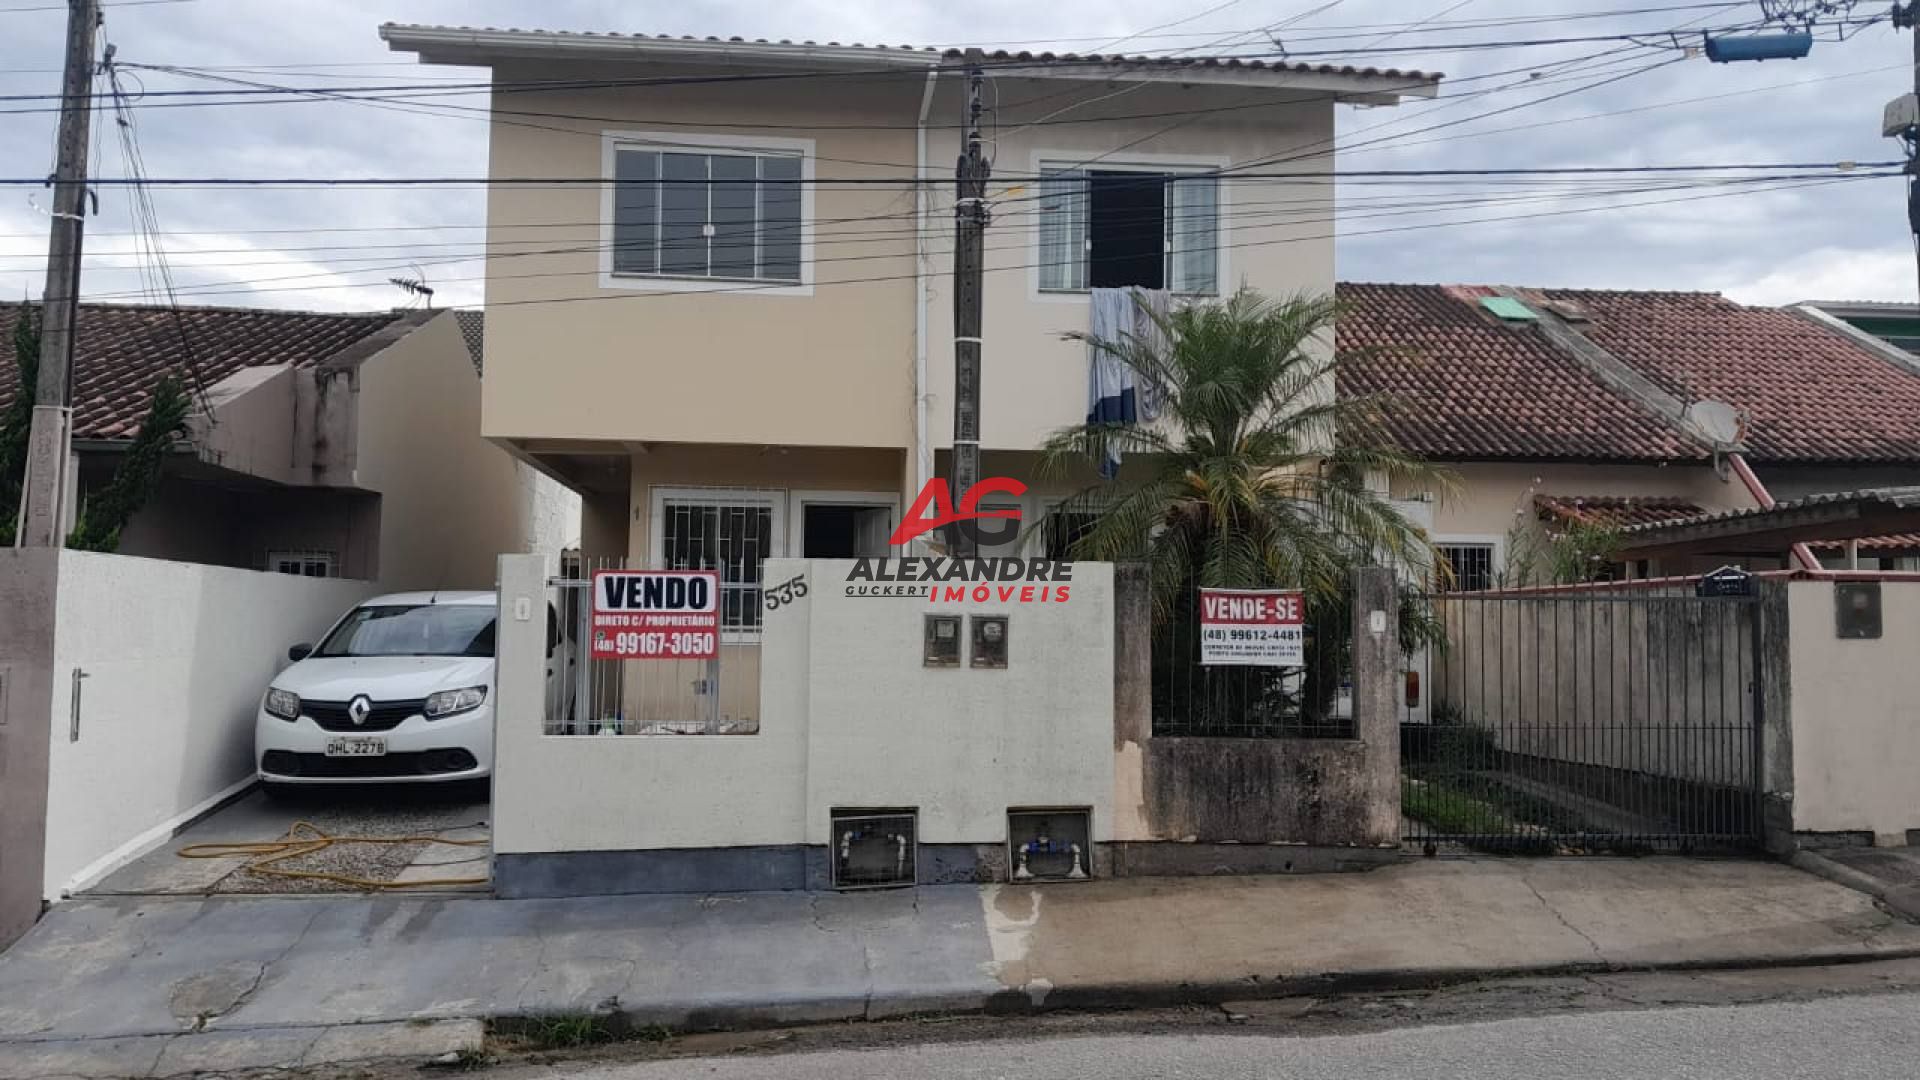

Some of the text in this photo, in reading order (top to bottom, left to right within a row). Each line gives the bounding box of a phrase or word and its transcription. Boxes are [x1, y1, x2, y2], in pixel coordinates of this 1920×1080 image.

[604, 576, 708, 609] VENDO
[765, 573, 808, 610] 535
[595, 613, 715, 626] DIRETO C/ PROPRIETÁRIO
[1205, 598, 1298, 620] VENDE-SE
[616, 633, 714, 654] 99167-3050
[1204, 629, 1300, 642] (48) 99612-4481
